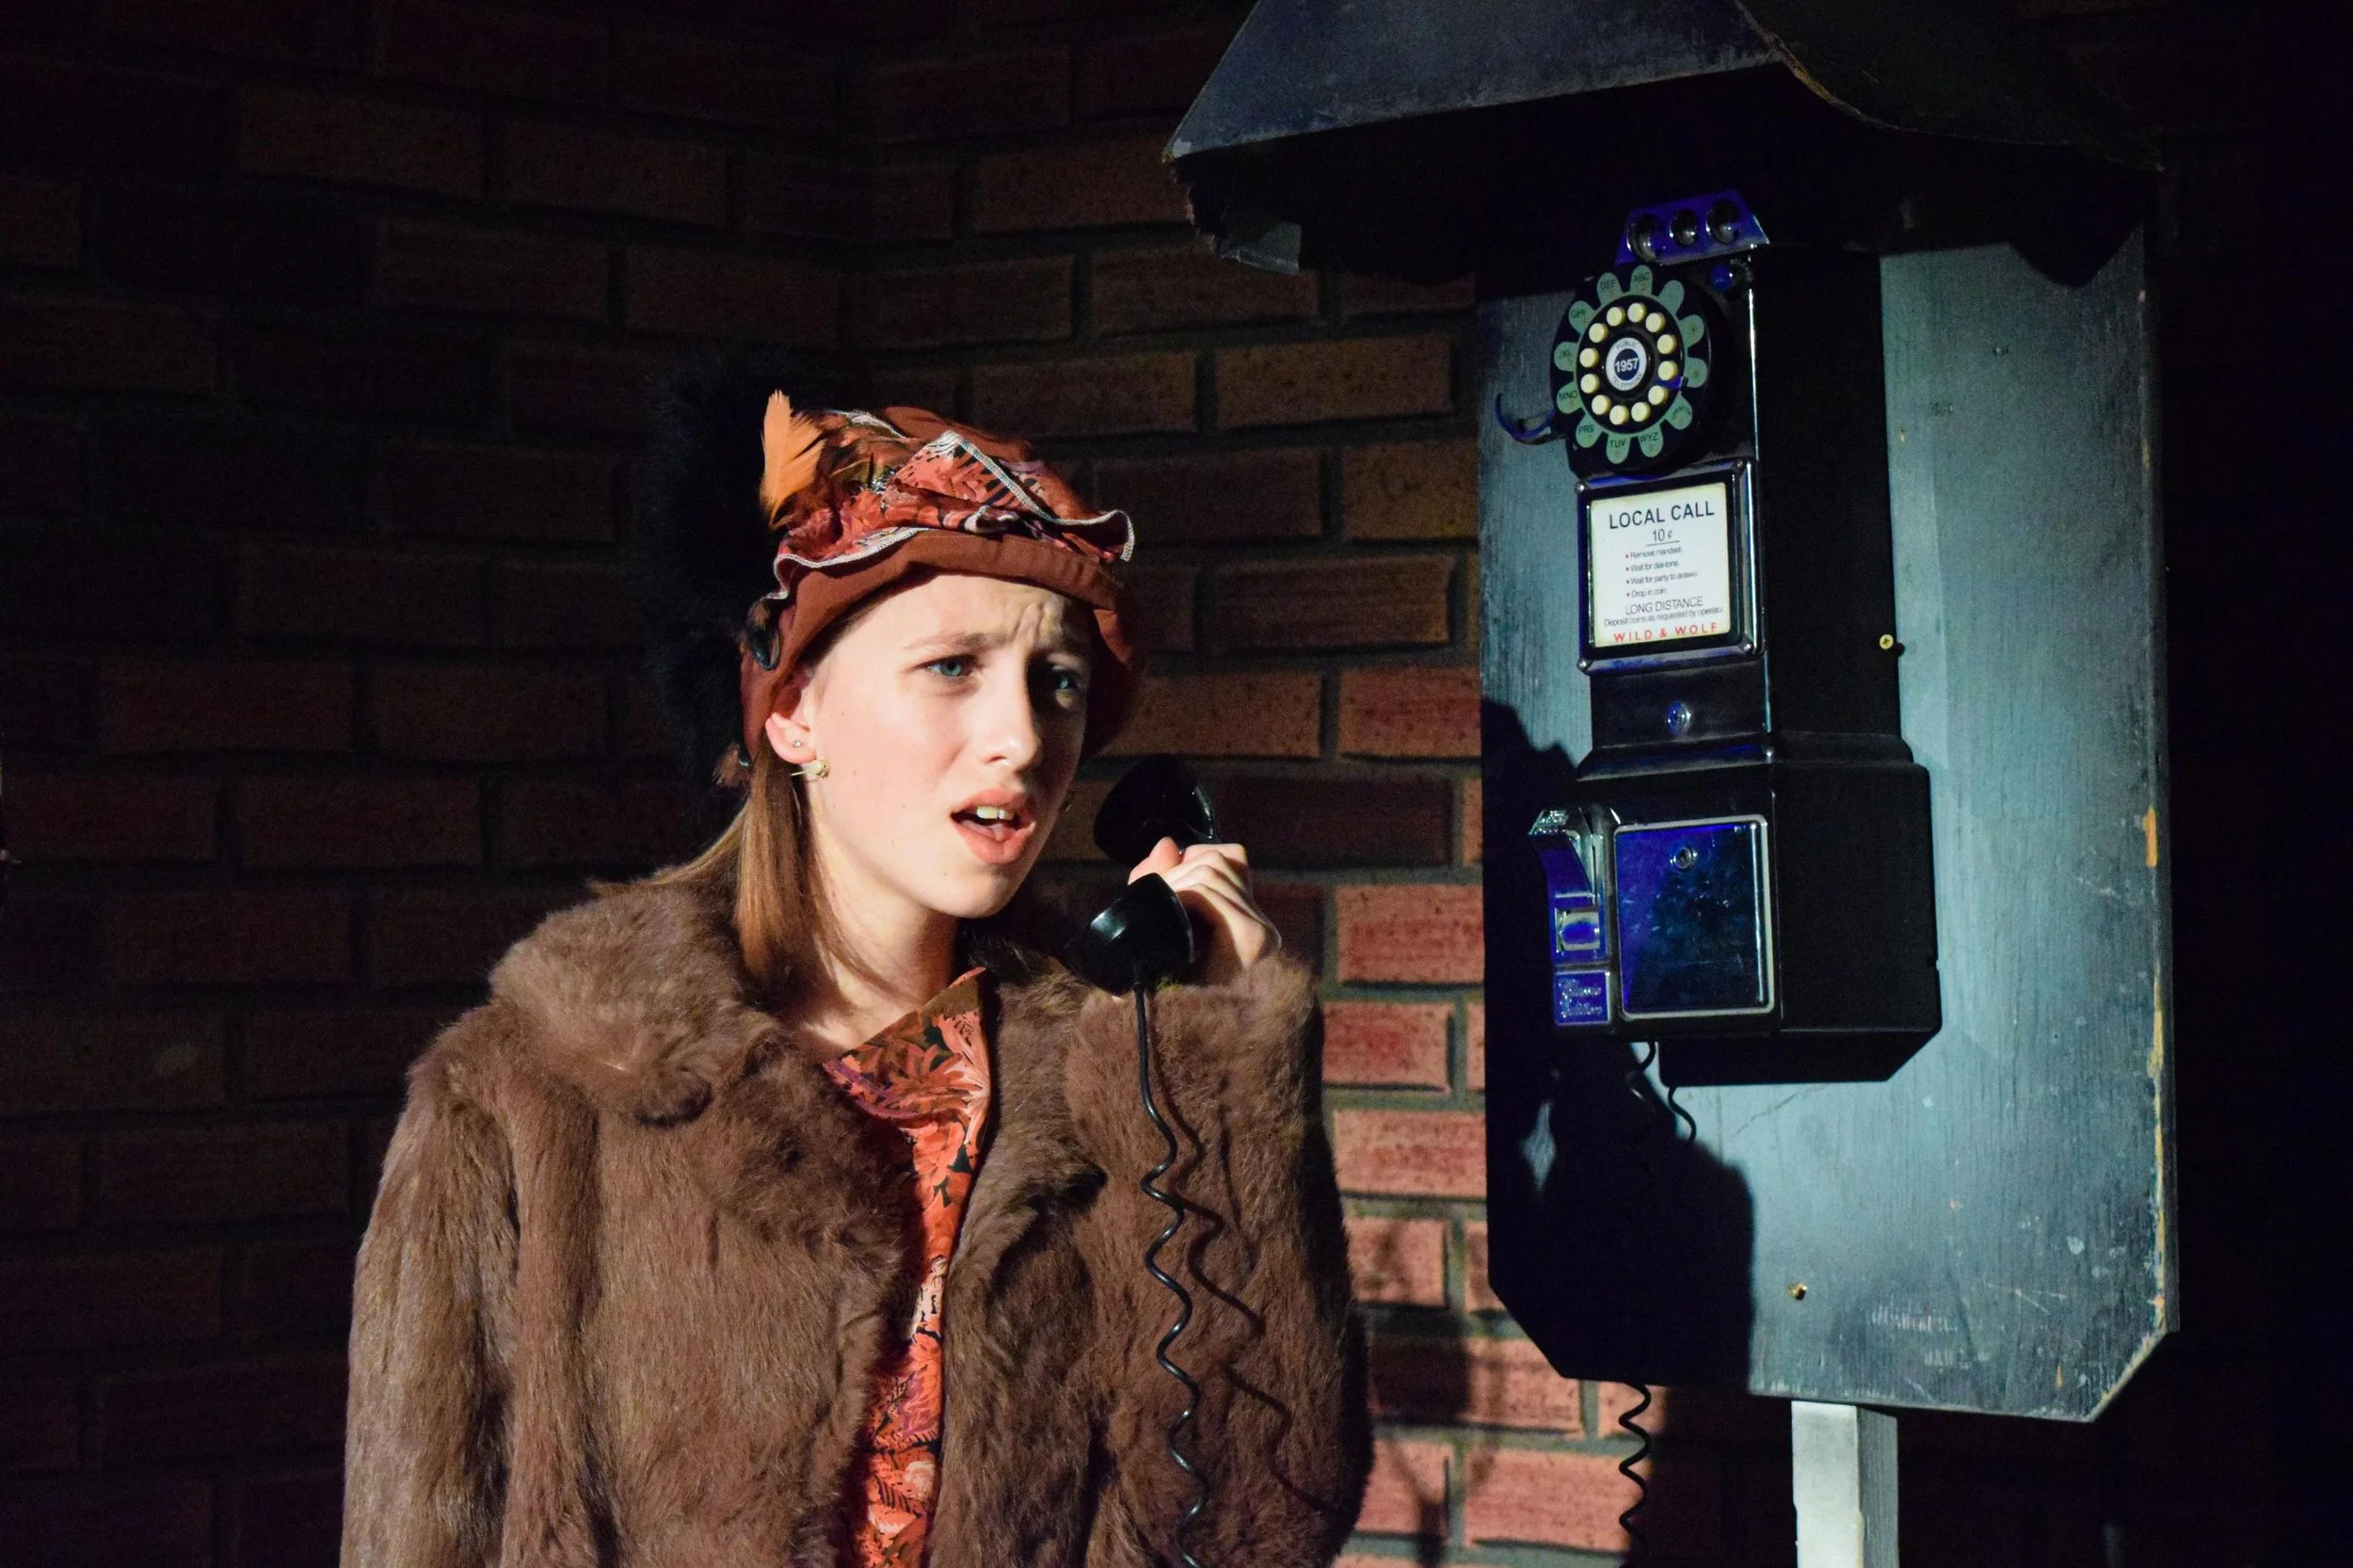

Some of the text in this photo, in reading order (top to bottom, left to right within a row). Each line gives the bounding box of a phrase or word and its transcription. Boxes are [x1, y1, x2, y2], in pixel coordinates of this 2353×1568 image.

[1615, 358, 1639, 373] 1957
[1578, 424, 1594, 434] PRS
[1609, 440, 1626, 448] TUV
[1609, 501, 1715, 529] LOCAL CALL
[1630, 550, 1656, 559] Remove
[1630, 564, 1643, 572] Wait
[1654, 574, 1669, 584] party
[1631, 589, 1646, 599] Drop
[1625, 596, 1704, 616] LONG DISTANCE
[1604, 616, 1627, 627] Deposit
[1656, 610, 1688, 621] requested
[1689, 608, 1697, 617] by
[1613, 622, 1718, 642] WILD & WOLF
